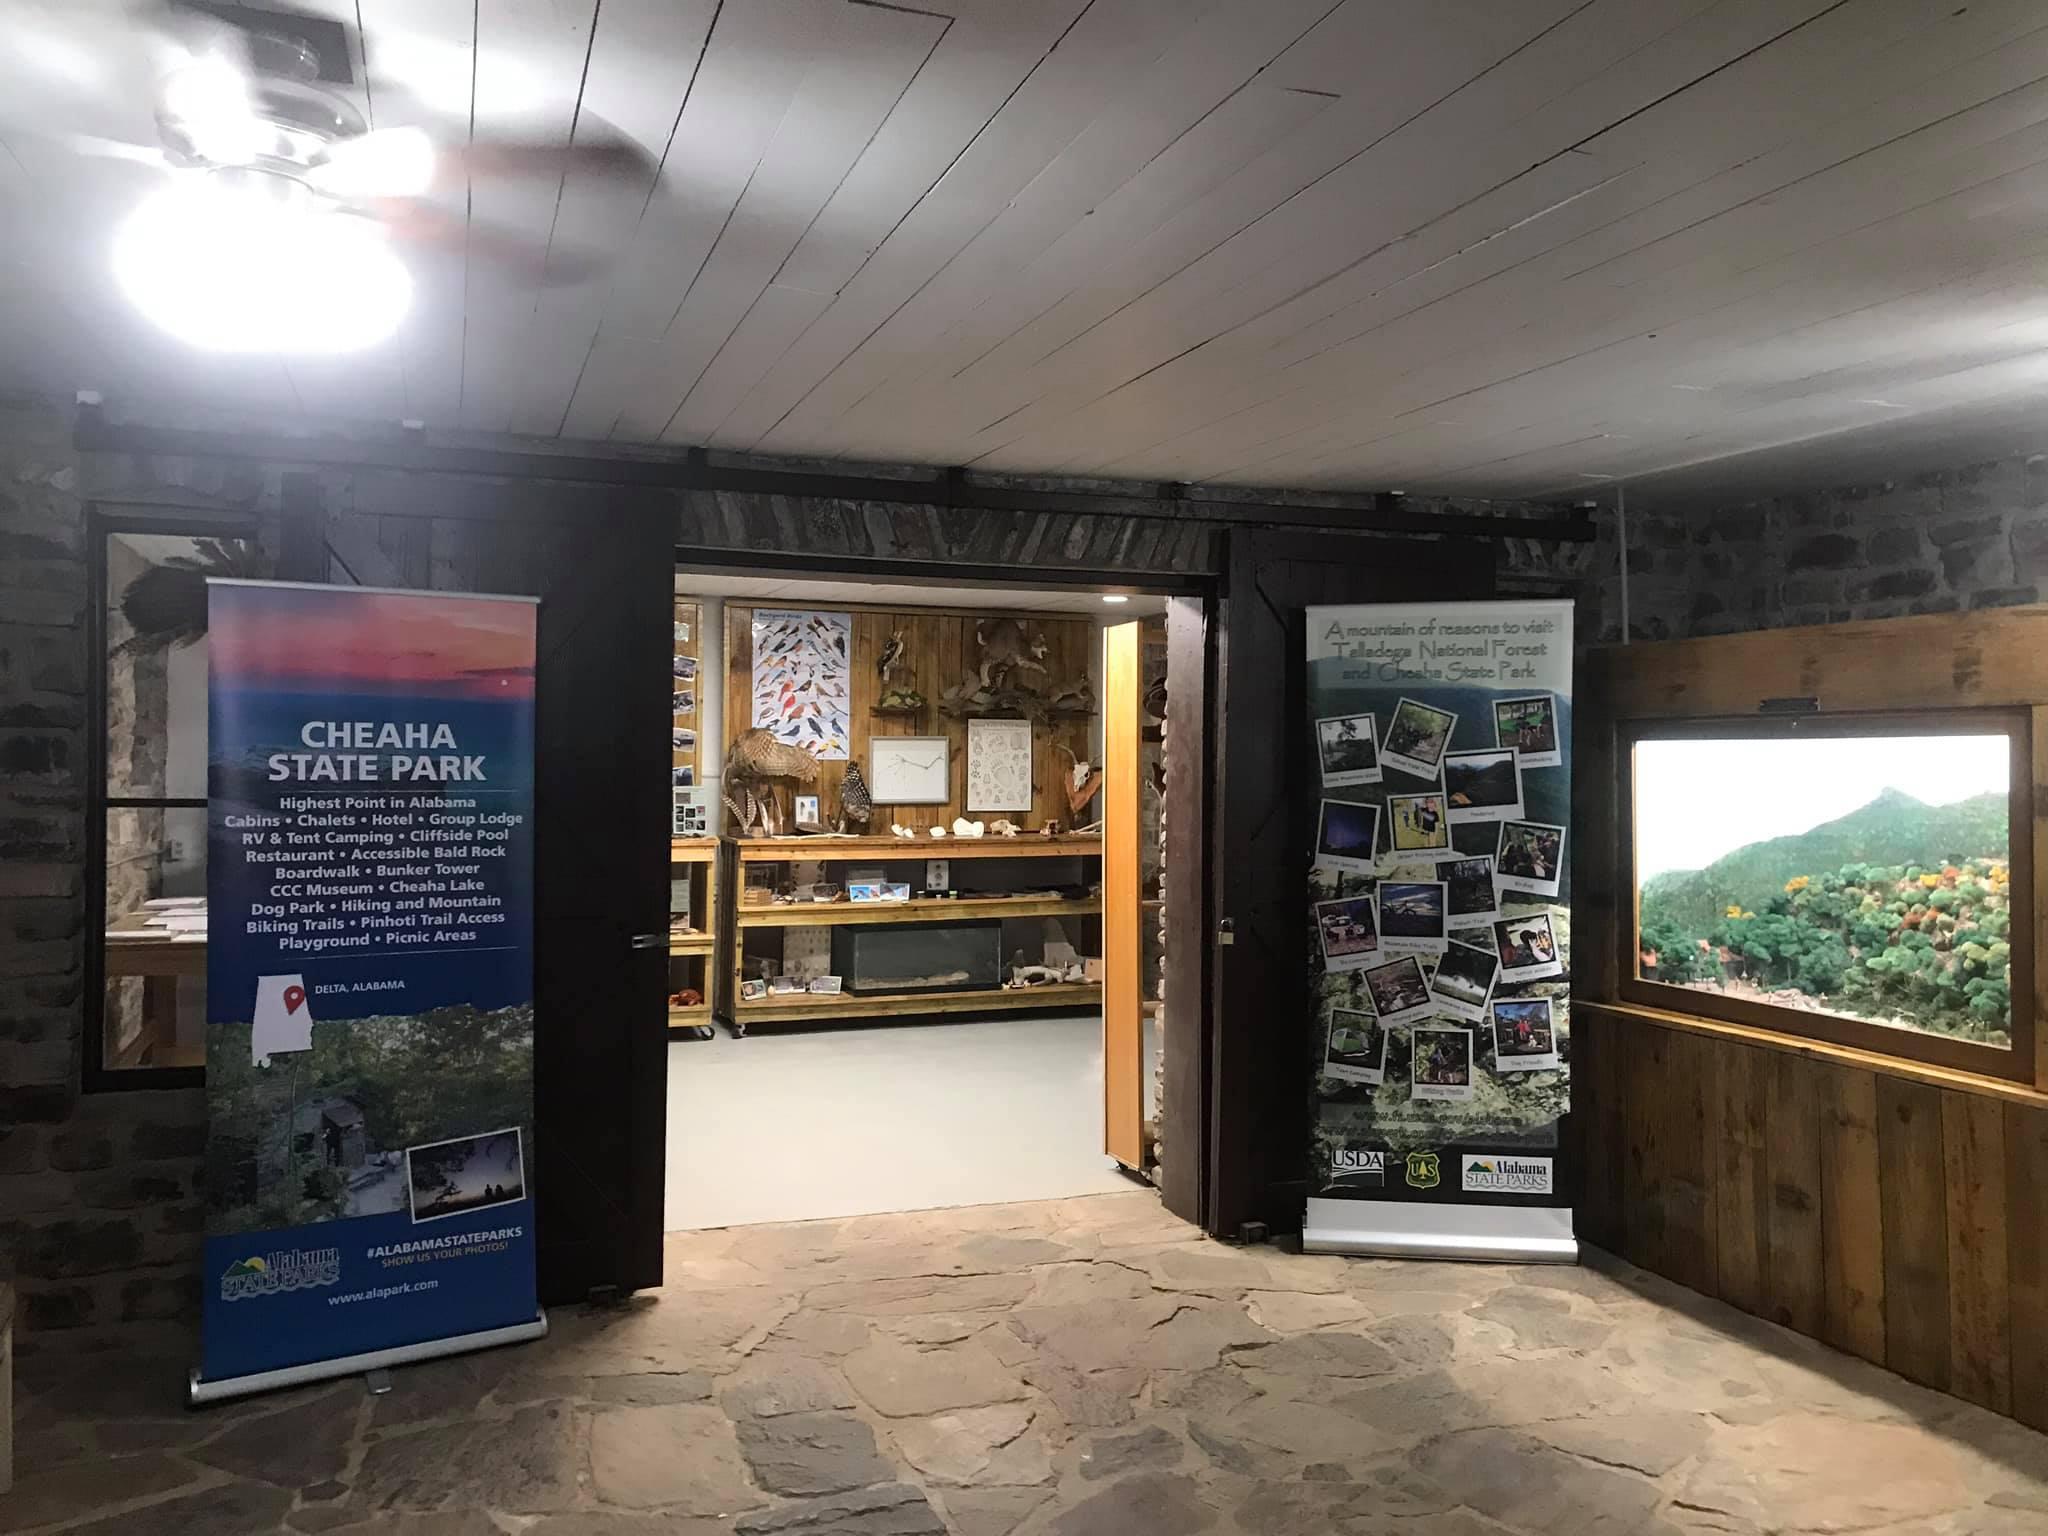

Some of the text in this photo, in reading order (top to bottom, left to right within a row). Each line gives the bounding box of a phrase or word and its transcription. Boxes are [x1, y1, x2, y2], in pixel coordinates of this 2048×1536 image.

[1324, 618, 1554, 640] A mountain of reasons to visit
[1419, 640, 1488, 660] National
[1492, 639, 1548, 658] Forest
[1342, 665, 1371, 679] and
[1445, 661, 1495, 681] State
[1499, 660, 1536, 680] Park
[301, 720, 457, 749] CHEAHA
[268, 754, 487, 781] STATE PARK
[280, 796, 476, 811] Highest Point in Alabama
[224, 812, 524, 829] Cabins Chalets Hotel Group Lodge
[242, 828, 509, 846] RV & Tent Camping Cliffside Pool
[246, 845, 506, 863] Restaurant Accessible Bald Rock
[275, 863, 480, 879] Boardwalk Bunker Tower
[270, 879, 485, 897] CCC Museum Cheaha Lake
[251, 895, 501, 918] Dog Park Hiking and Mountain
[246, 912, 505, 936] Biking Trails Pinhoti Trail Access
[279, 929, 477, 951] Playground Picnic Areas
[315, 980, 405, 994] DELTA, ALABAMA
[1332, 1151, 1383, 1168] USDA
[1495, 1160, 1547, 1175] Alabama
[1465, 1173, 1548, 1186] STATE PARKS
[367, 1226, 522, 1259] #ALABAMASTATEPARKS
[382, 1241, 509, 1268] SHOW US YOUR PHOTOS!
[328, 1278, 439, 1306] www.alapark.com
